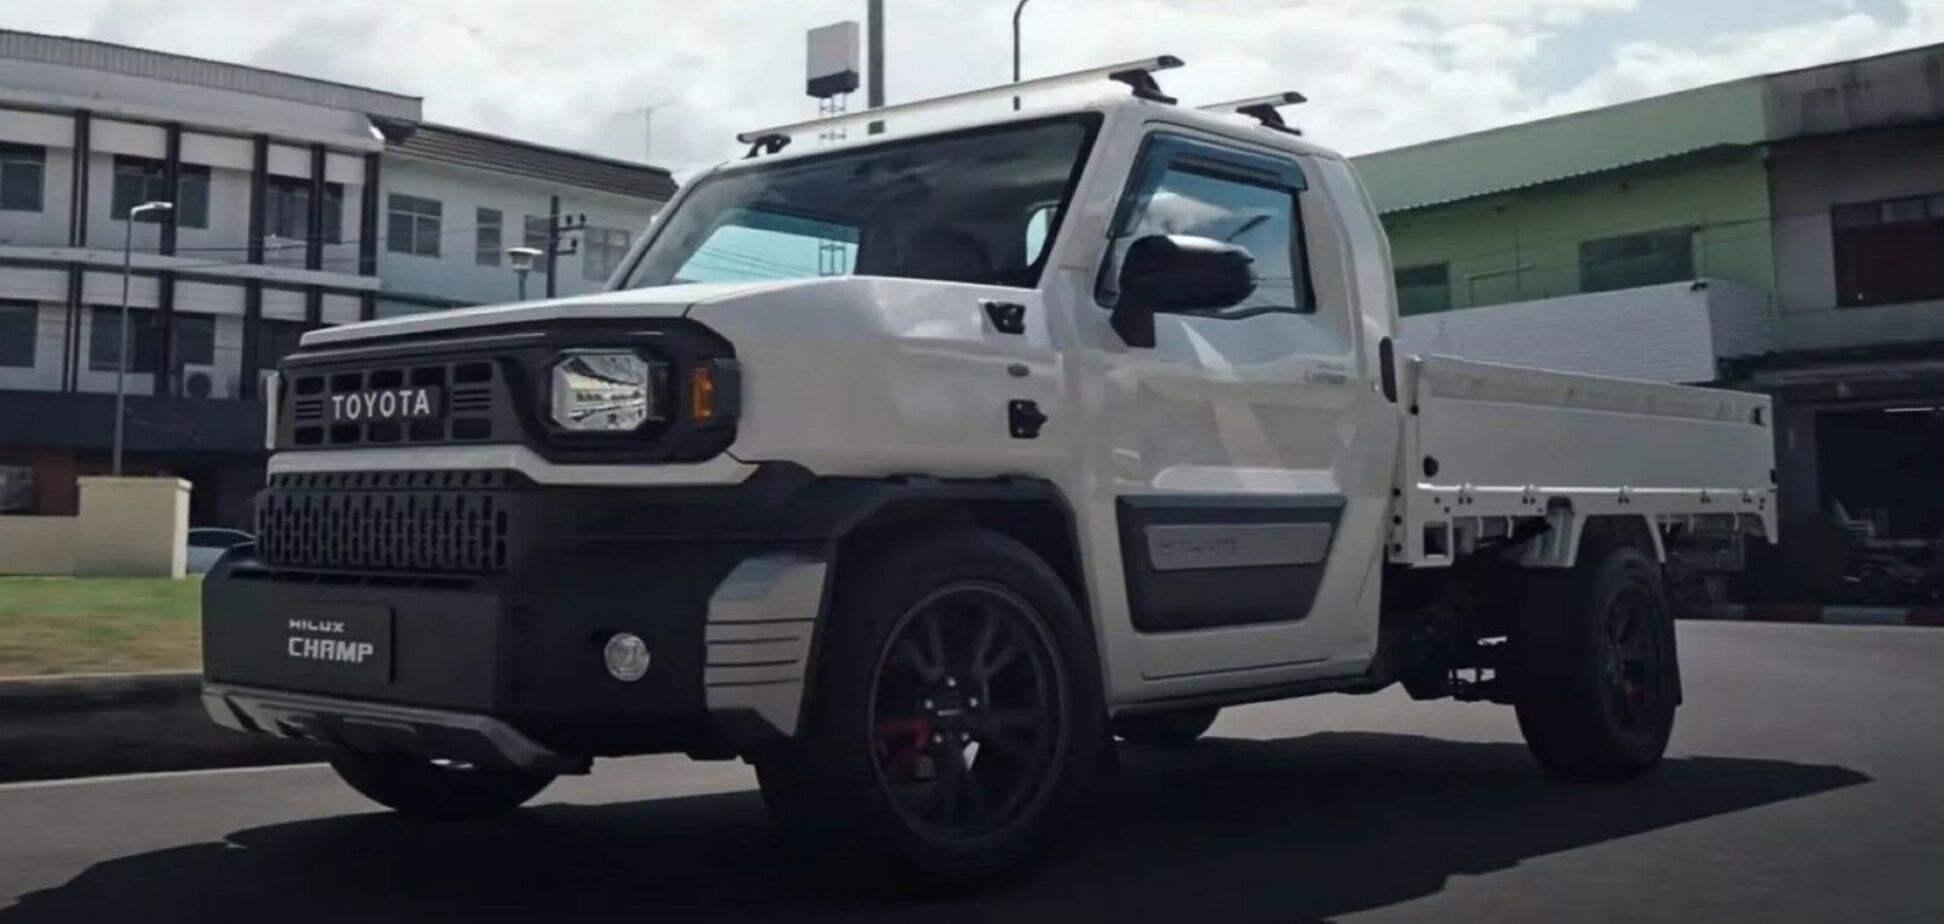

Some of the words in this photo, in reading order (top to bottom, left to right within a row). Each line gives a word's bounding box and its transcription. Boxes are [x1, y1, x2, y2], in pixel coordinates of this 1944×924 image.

[331, 388, 431, 420] TOYOTA
[288, 618, 345, 634] HILUX
[288, 637, 374, 663] CHAMP
